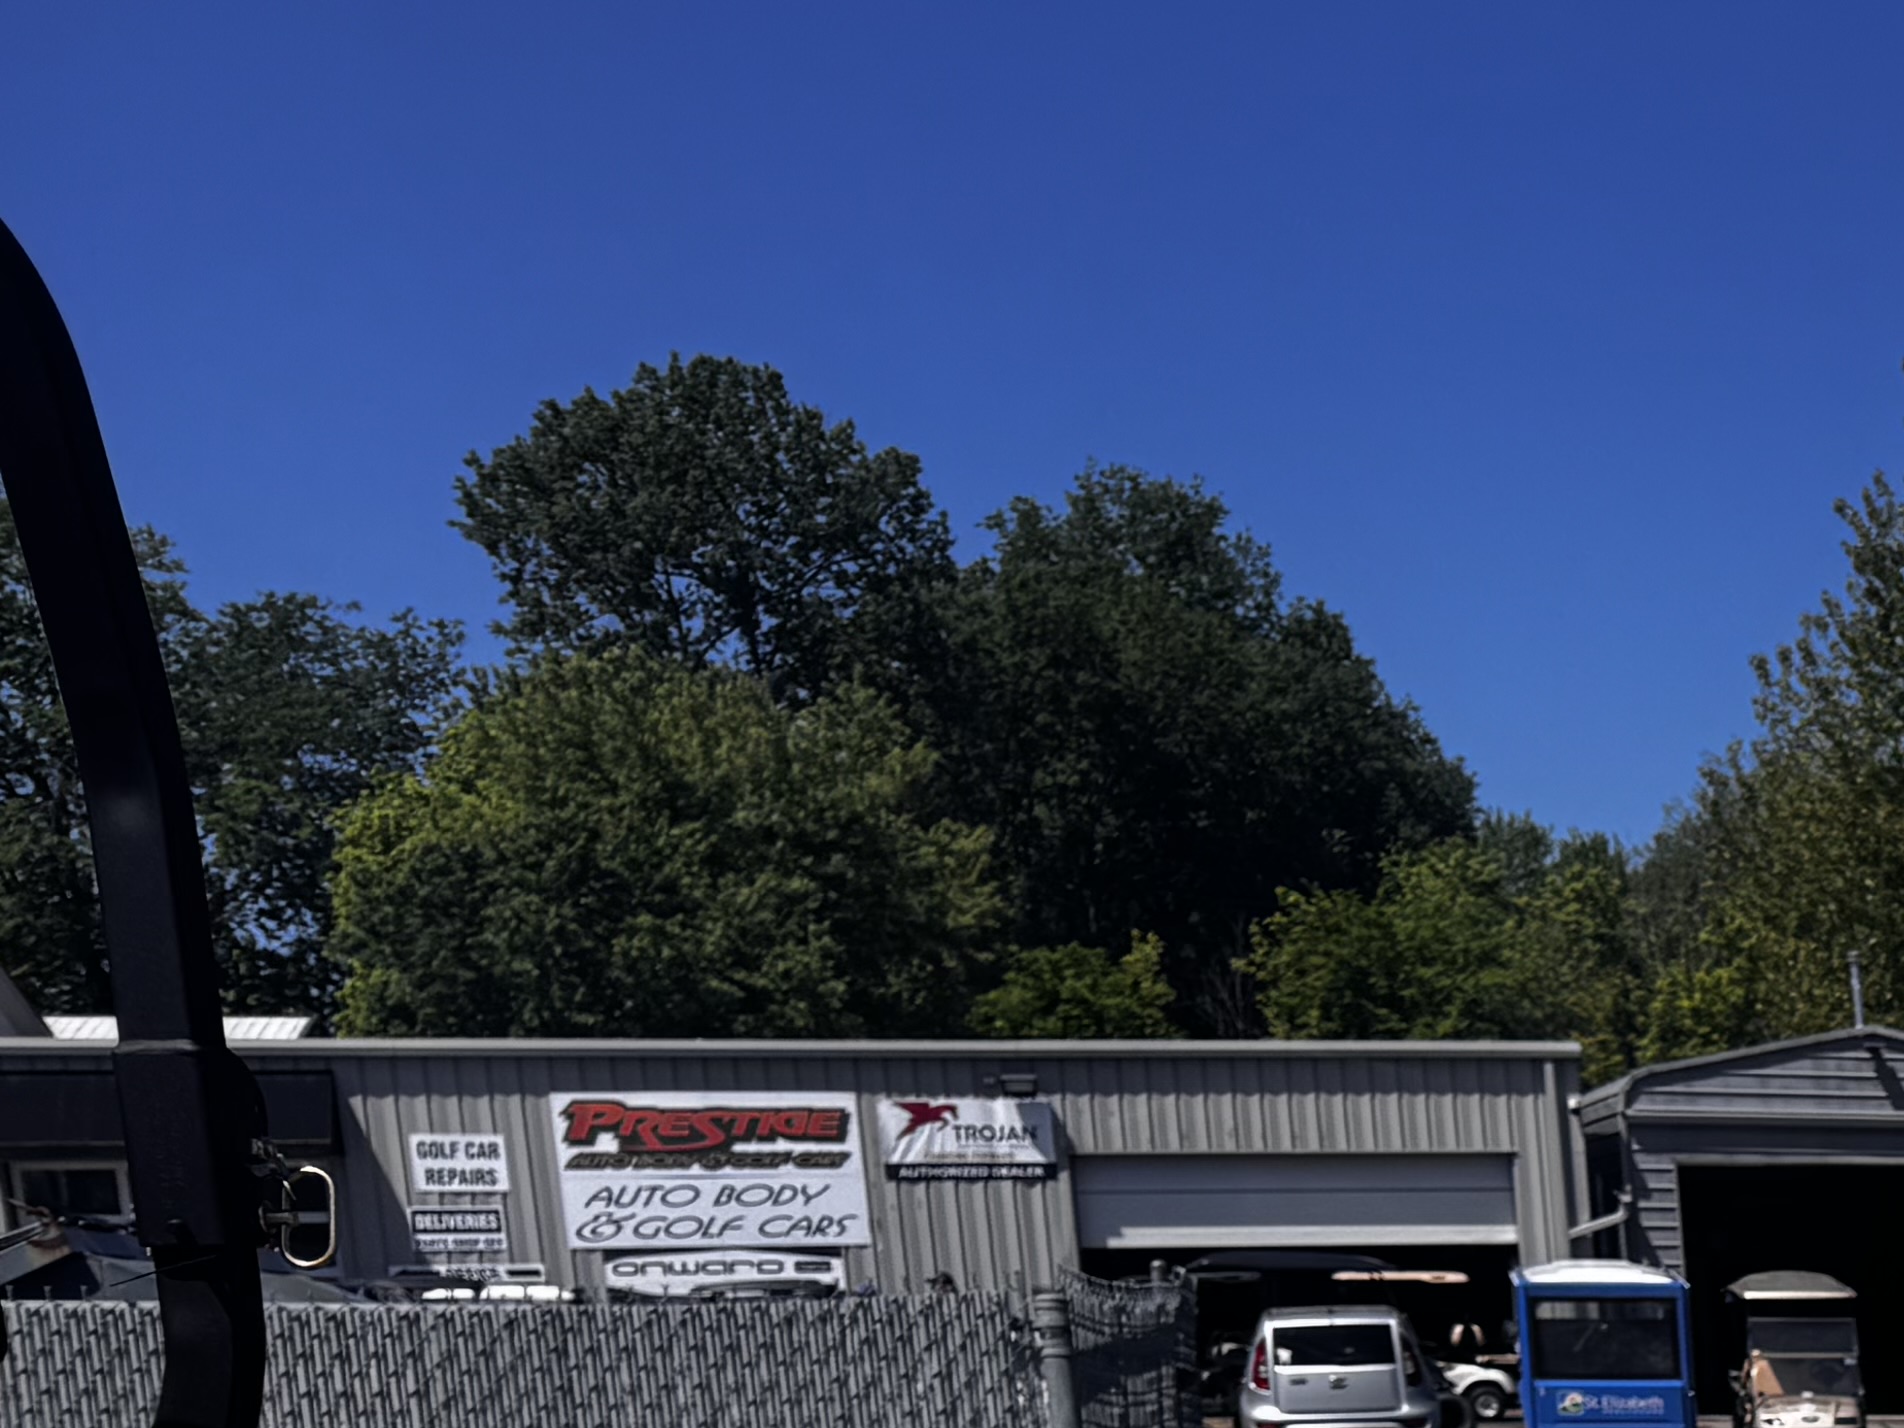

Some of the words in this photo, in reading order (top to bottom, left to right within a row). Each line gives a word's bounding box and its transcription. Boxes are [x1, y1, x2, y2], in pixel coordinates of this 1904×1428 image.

[953, 1124, 1039, 1143] TROJAN
[416, 1140, 460, 1160] GOLF
[424, 1167, 498, 1186] REPAIRS
[584, 1184, 701, 1209] AUTO
[712, 1183, 832, 1207] BODY
[415, 1213, 498, 1231] DELIVERIES
[632, 1215, 746, 1240] GOLF
[758, 1214, 859, 1238] CARS
